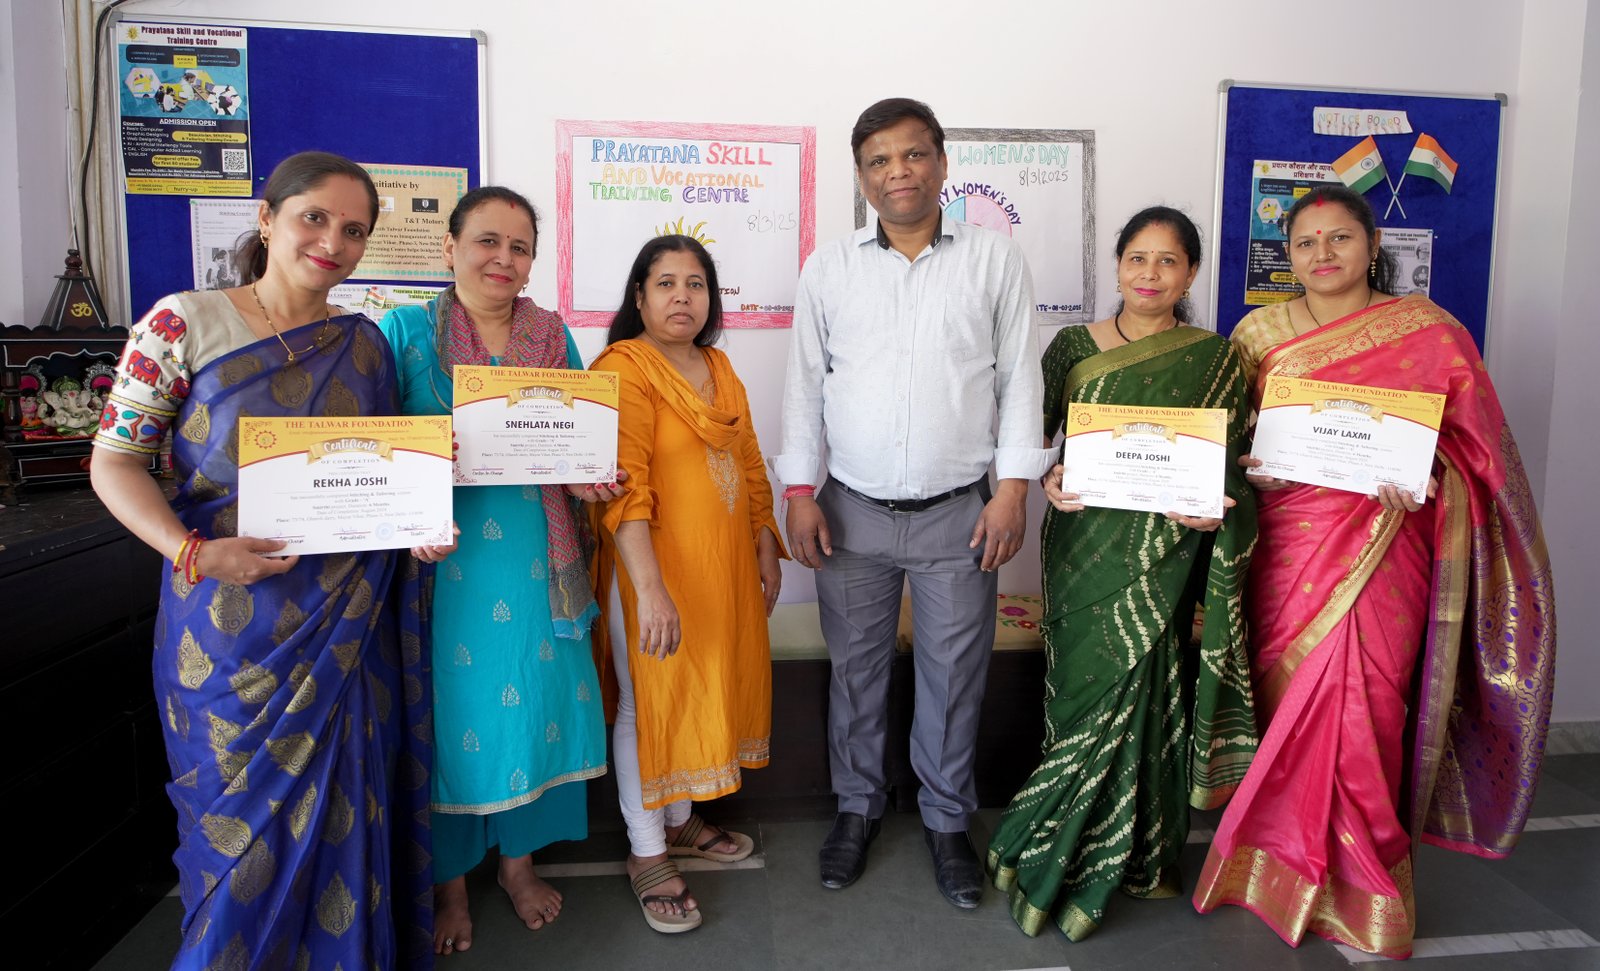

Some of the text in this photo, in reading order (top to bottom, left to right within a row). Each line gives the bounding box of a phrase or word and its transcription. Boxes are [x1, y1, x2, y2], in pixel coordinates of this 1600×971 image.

[141, 26, 175, 36] Prayatana
[177, 27, 191, 35] Skill
[207, 28, 242, 37] Vocational
[167, 37, 217, 46] Training Centre
[159, 118, 217, 127] ADMISSION OPEN
[591, 139, 772, 166] PRAYATANA SKILL
[1038, 143, 1069, 169] DAY
[602, 163, 765, 189] AND VOCATIONAL
[375, 180, 420, 192] nitiative by
[589, 182, 749, 204] TRAINING CENTRE
[952, 182, 1007, 206] WOMEN'S
[1004, 204, 1022, 225] DAY
[490, 369, 591, 380] THE TALWAR FOUNDATION
[519, 387, 562, 399] Certificate
[1299, 381, 1408, 399] THE TALWAR FOUNDATION
[1113, 407, 1145, 415] TALWAR
[1145, 408, 1195, 417] FOUNDATION
[1324, 399, 1371, 413] Certificate
[285, 419, 414, 429] THE TALWAR FOUNDATION
[505, 420, 575, 430] SNEHLATA NEGI
[1313, 426, 1371, 441] VIJAY LAXMI
[323, 438, 378, 453] Certificate
[1116, 451, 1170, 462] DEEPA JOSHI
[313, 476, 387, 488] REKHA JOSHI
